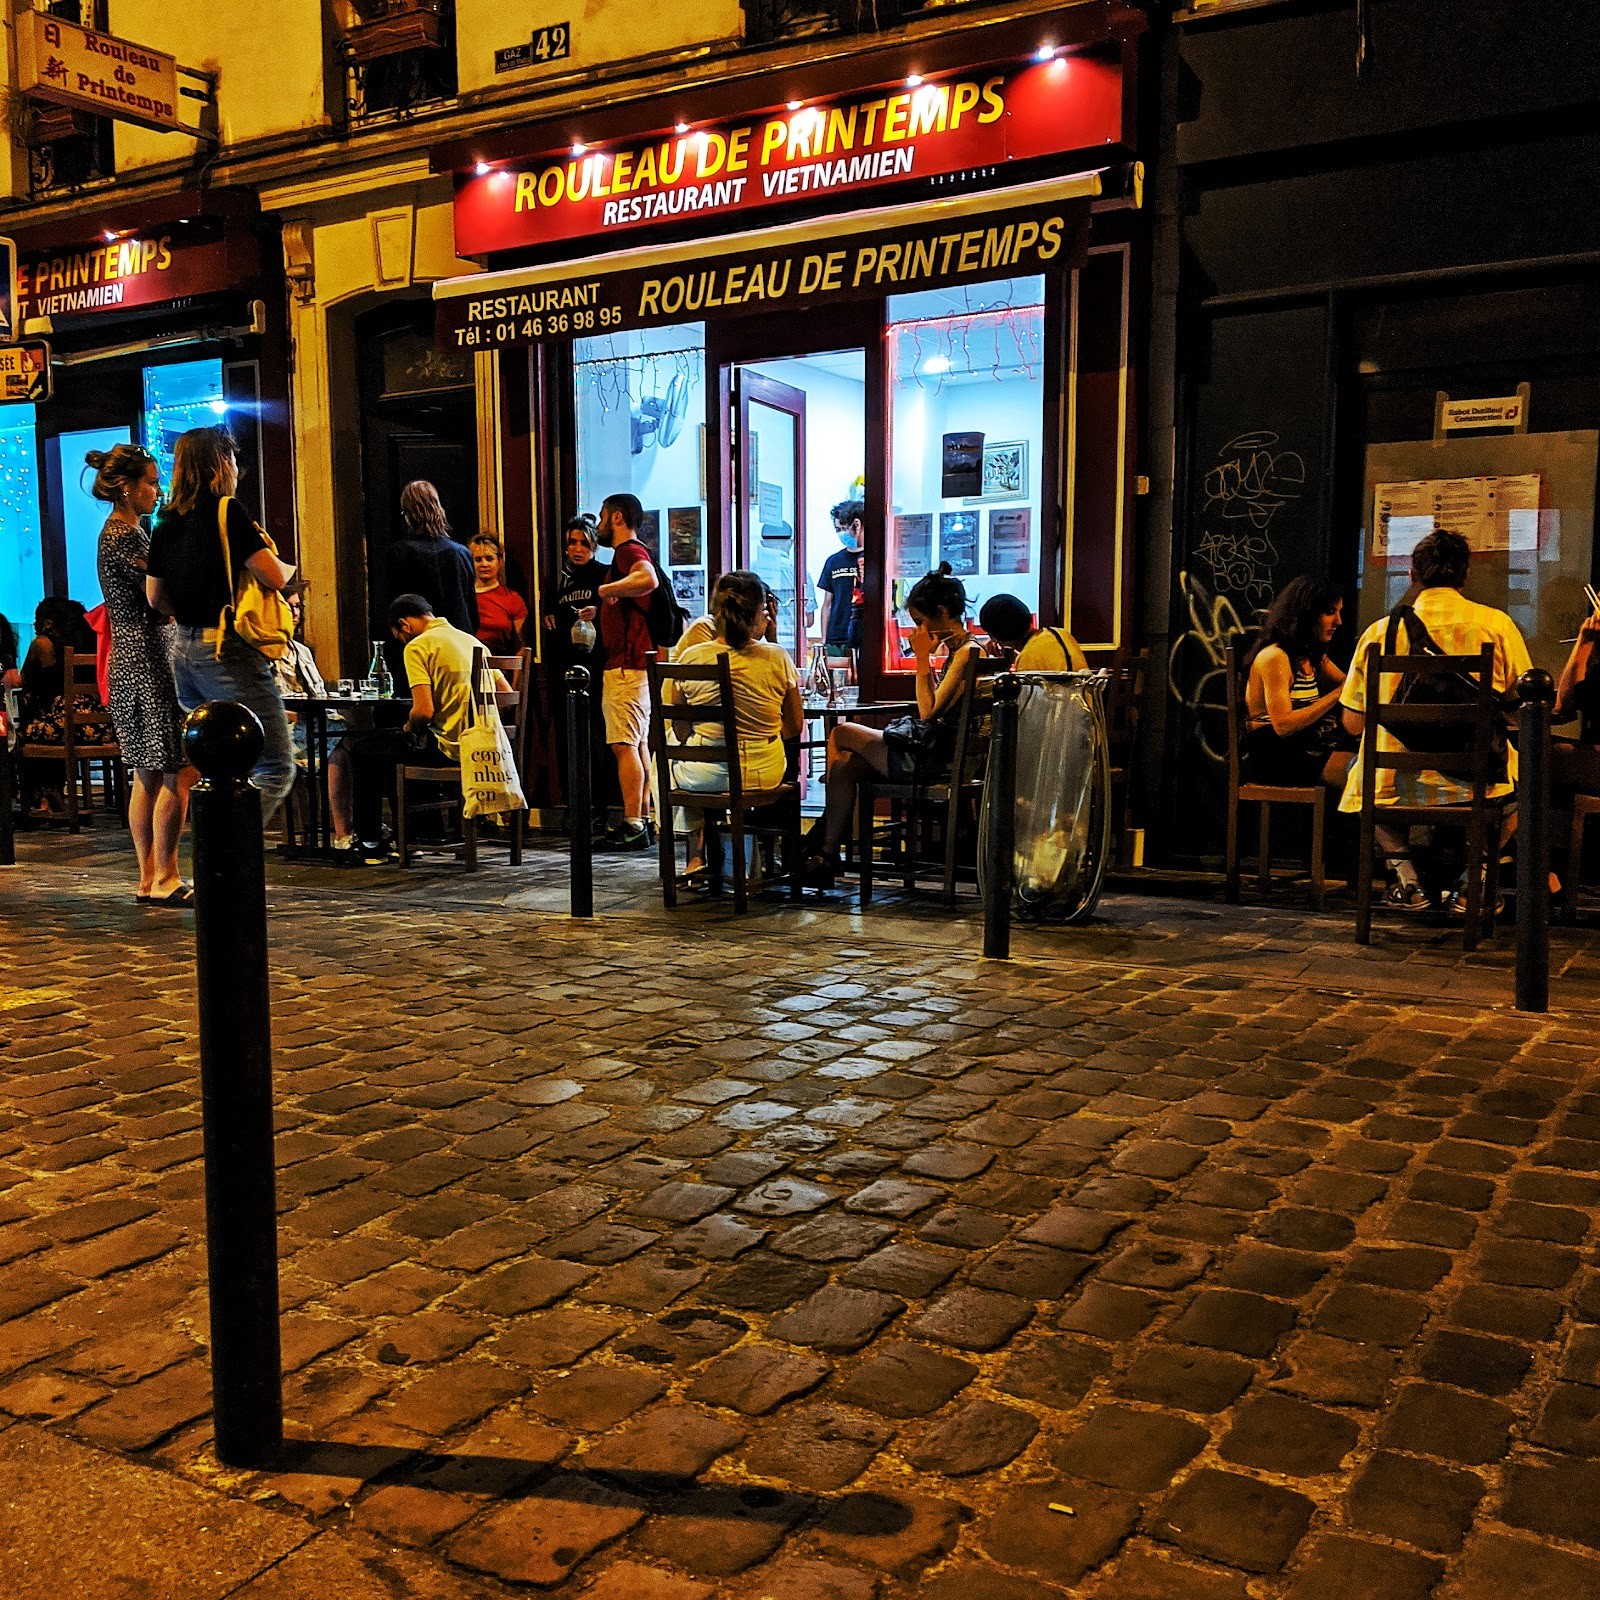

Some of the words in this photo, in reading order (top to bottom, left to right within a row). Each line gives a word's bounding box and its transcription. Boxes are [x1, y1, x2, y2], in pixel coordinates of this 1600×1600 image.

[84, 32, 160, 72] Rouleau
[503, 47, 522, 60] GAZ
[535, 27, 566, 60] 42
[77, 72, 173, 117] Printemps
[113, 65, 136, 85] de
[514, 137, 687, 213] ROULEAU
[696, 127, 751, 178] DE
[760, 76, 1005, 166] PRINTEMPS
[603, 177, 747, 226] RESTAURANT
[762, 146, 915, 198] VIETNAMIEN
[35, 235, 172, 294] PRINTEMPS
[638, 258, 792, 317] ROULEAU
[798, 250, 847, 294] DE
[852, 216, 1065, 287] PRINTEMPS
[38, 282, 124, 316] VIETNAMIEN
[468, 282, 600, 322] RESTAURANT
[454, 326, 480, 346] Tél
[496, 322, 516, 341] 01
[521, 318, 543, 338] 46
[547, 315, 569, 334] 36
[573, 310, 595, 330] 98
[600, 306, 622, 327] 95
[1454, 414, 1502, 423] Construction
[476, 790, 496, 802] en
